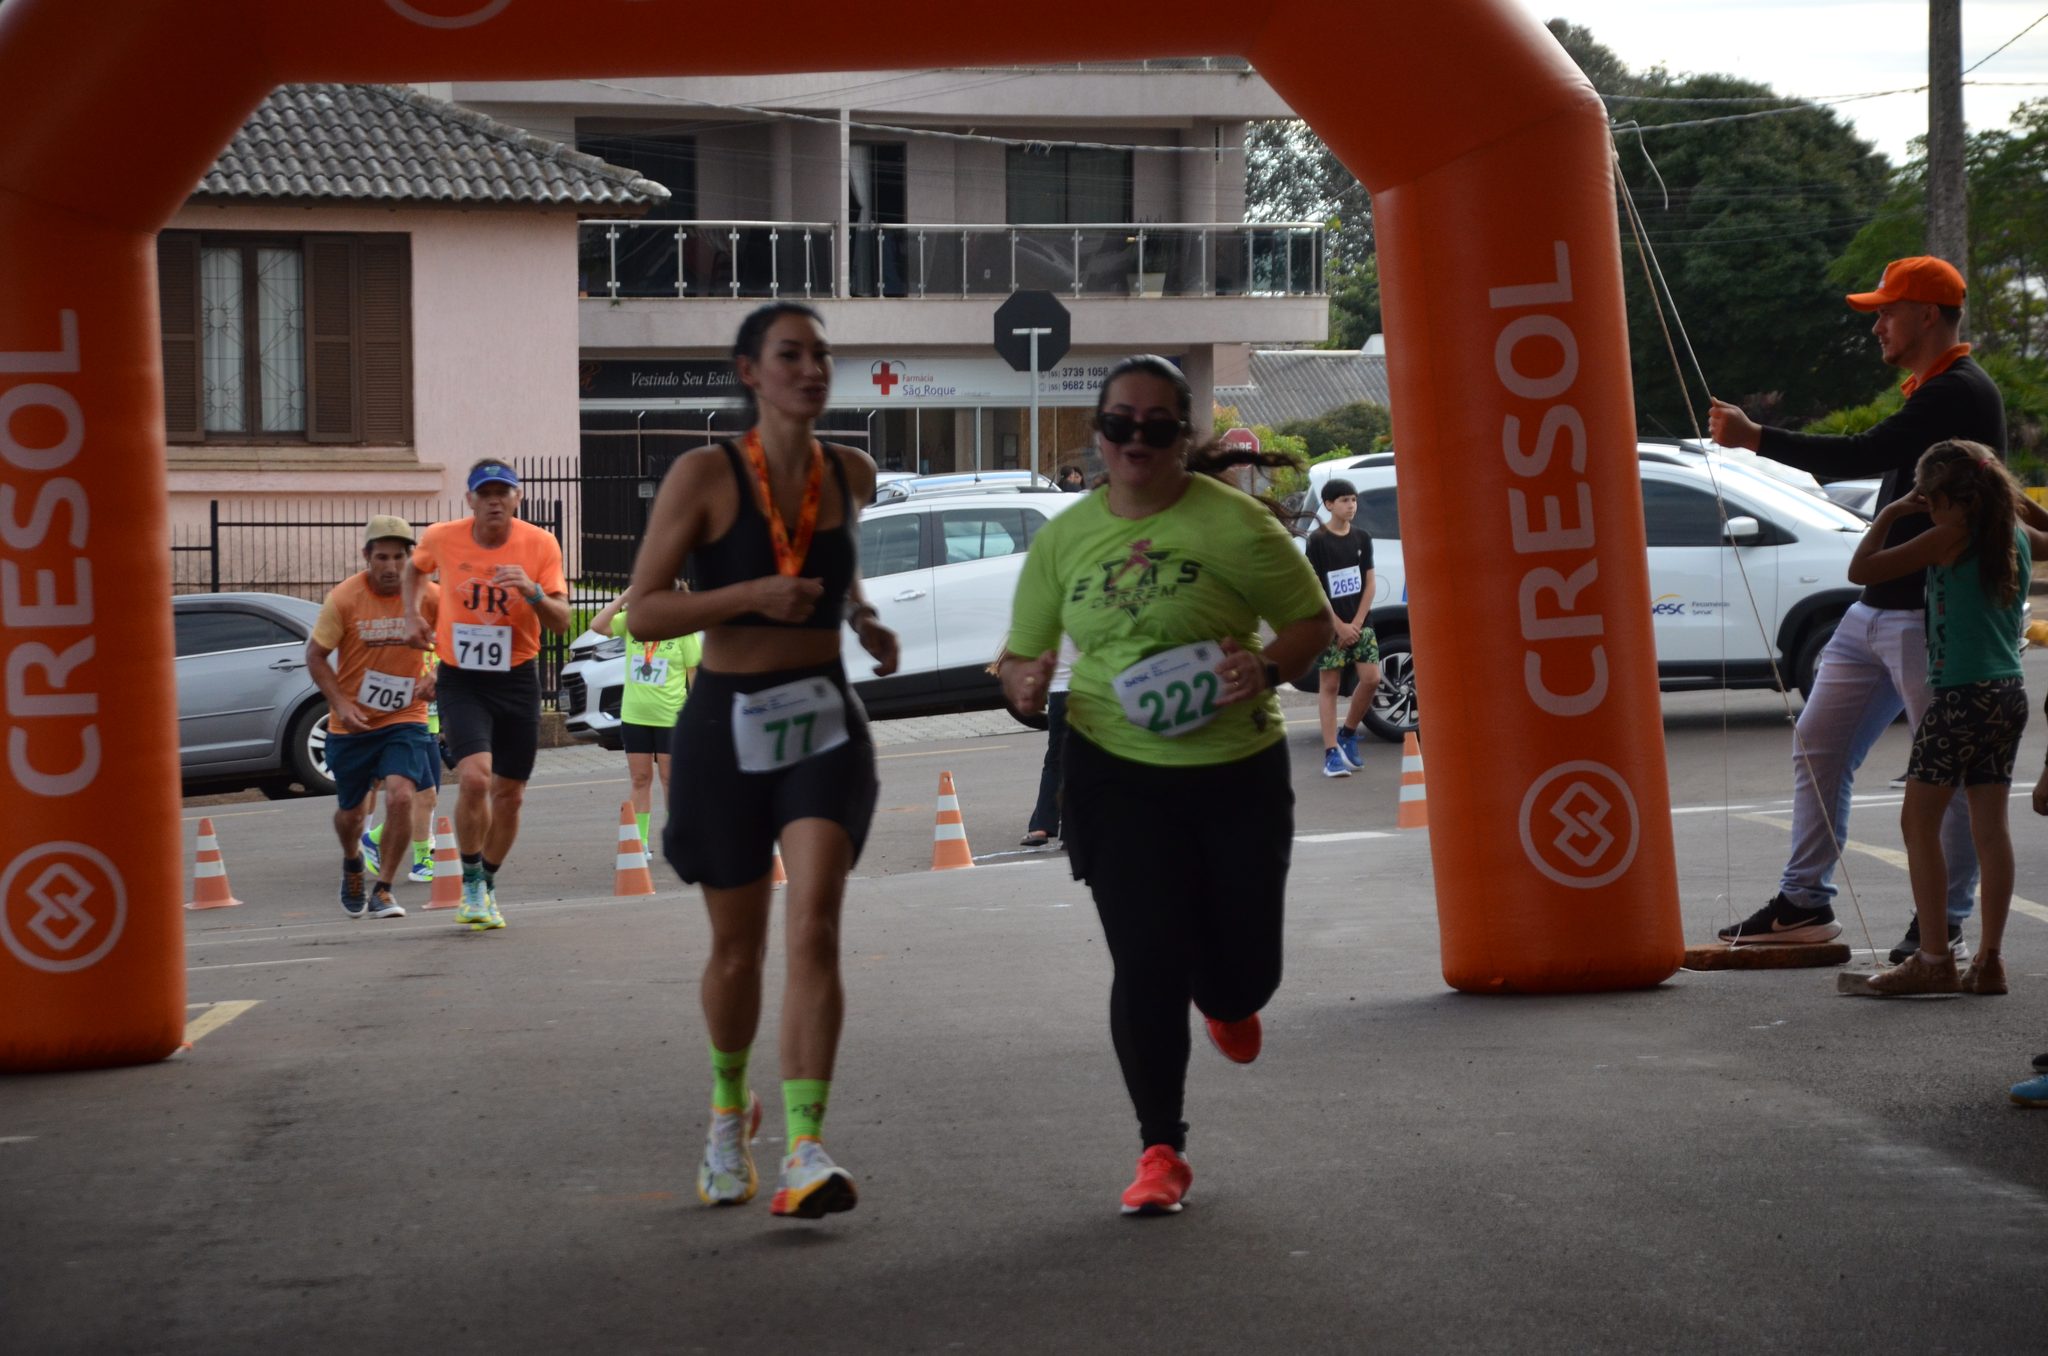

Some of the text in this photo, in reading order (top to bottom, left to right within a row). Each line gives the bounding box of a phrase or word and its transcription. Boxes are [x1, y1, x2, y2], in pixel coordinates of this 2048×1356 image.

[631, 371, 739, 387] Vestindo Seu Estilo
[902, 373, 934, 383] Farmácia
[1062, 367, 1084, 377] 3739
[902, 384, 921, 396] São
[923, 384, 956, 397] Roque
[1062, 380, 1084, 390] 9682
[1489, 240, 1608, 716] CRESOL
[0, 308, 101, 796] CRESOL
[1333, 576, 1361, 595] 2655
[463, 583, 511, 616] JR
[458, 640, 503, 666] 719
[366, 685, 406, 710] 705
[1139, 670, 1217, 732] 222
[764, 711, 817, 761] 77
